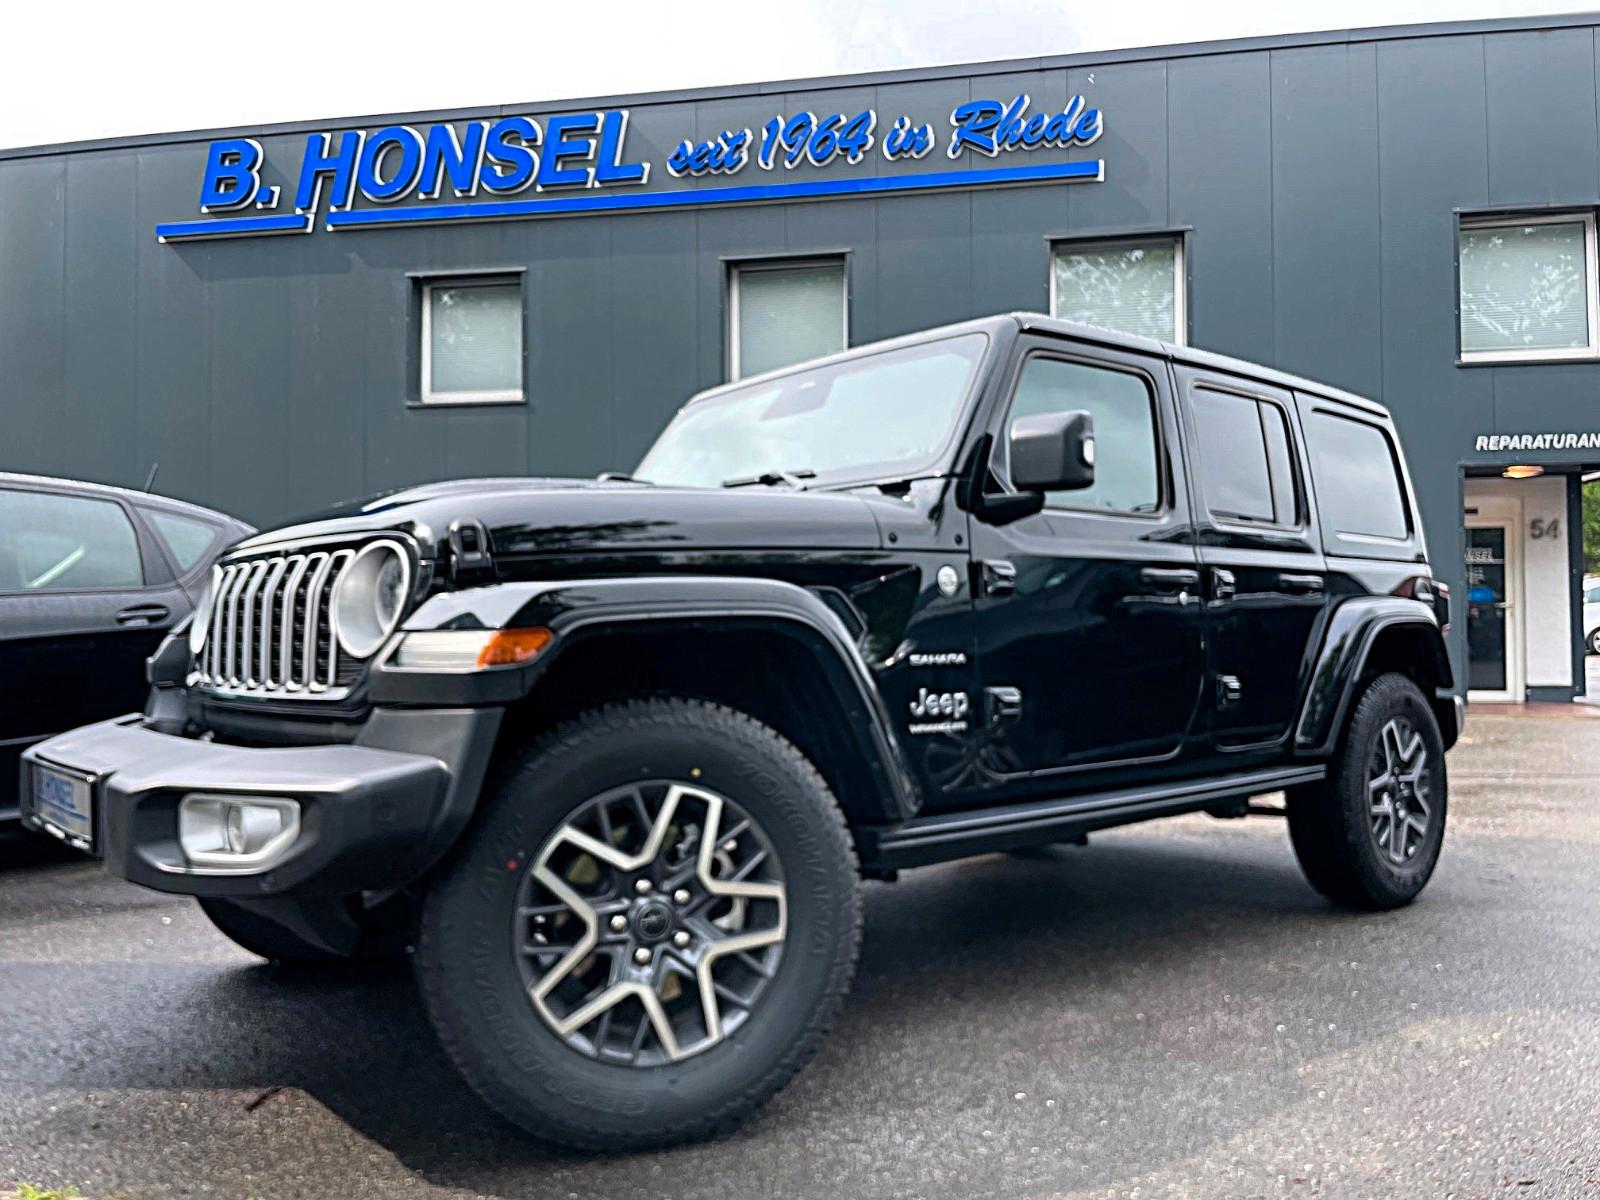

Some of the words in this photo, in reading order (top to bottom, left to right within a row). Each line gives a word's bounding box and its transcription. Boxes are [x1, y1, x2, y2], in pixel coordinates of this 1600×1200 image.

[201, 138, 280, 213] B.
[295, 110, 651, 214] HONSEL
[667, 128, 753, 177] seit
[758, 109, 878, 170] 1964
[883, 115, 935, 162] in
[947, 94, 1105, 158] Rhede
[1529, 518, 1561, 540] 54
[909, 687, 969, 720] Jeep
